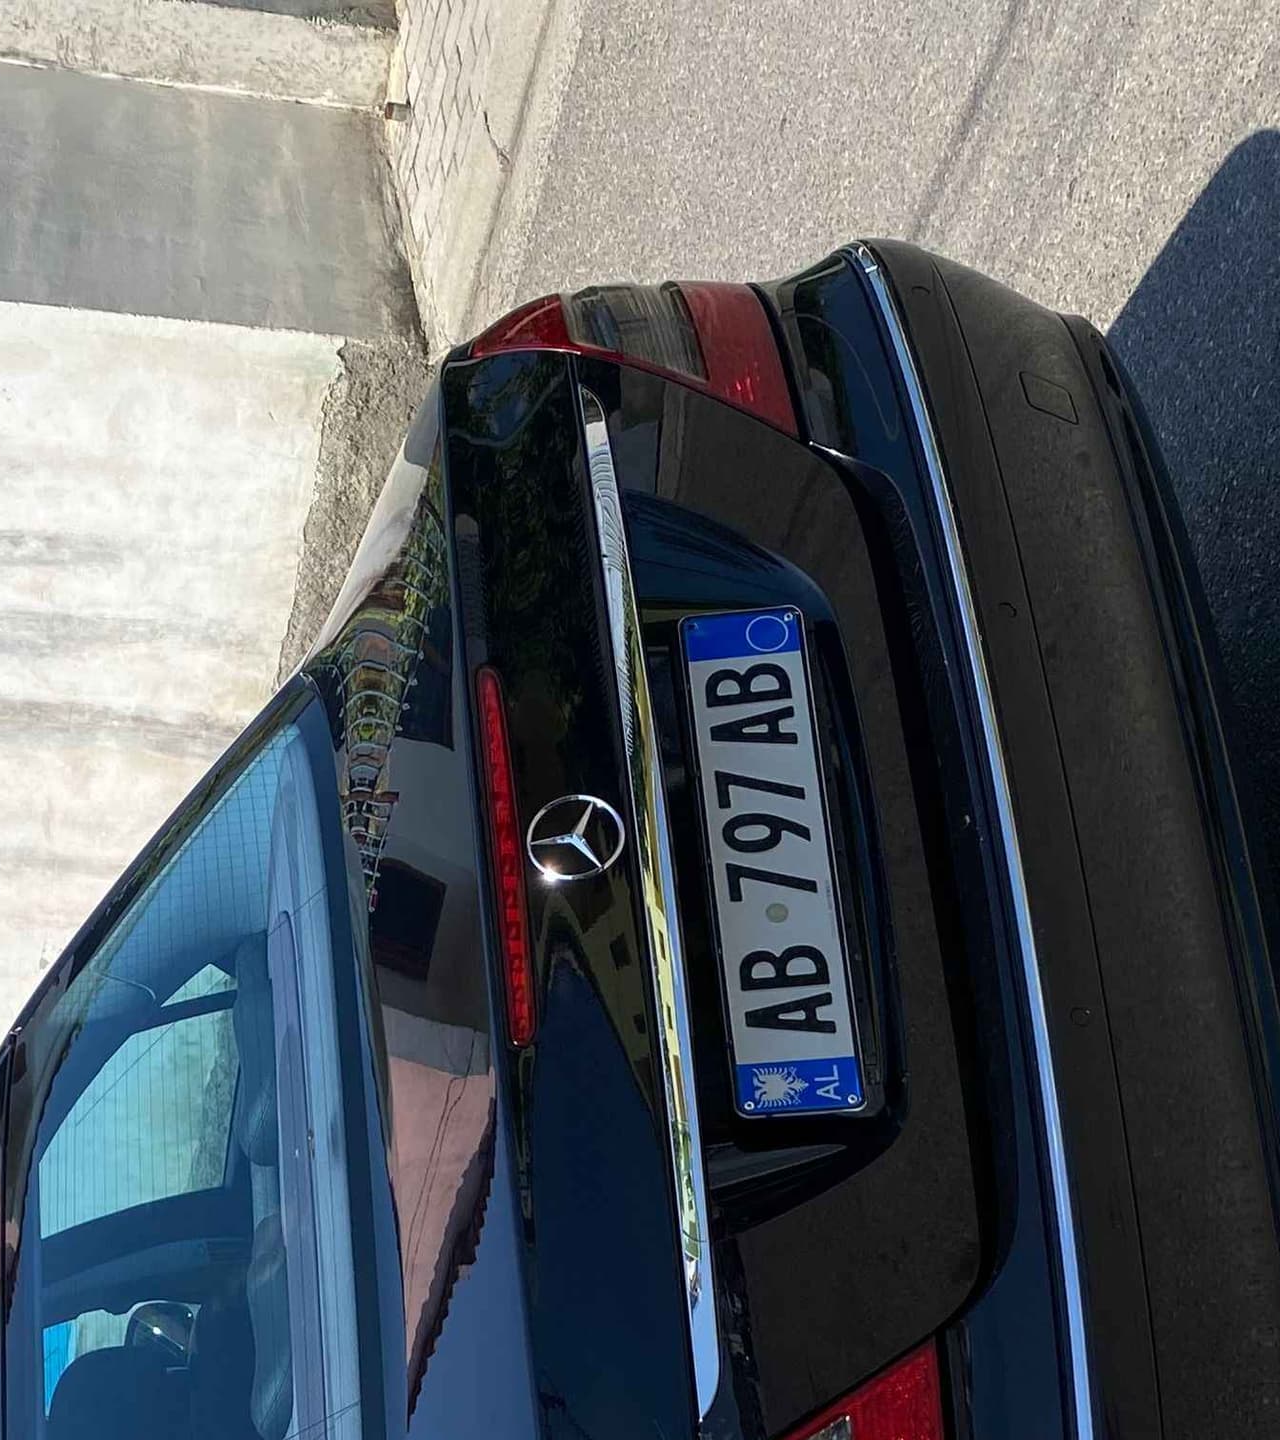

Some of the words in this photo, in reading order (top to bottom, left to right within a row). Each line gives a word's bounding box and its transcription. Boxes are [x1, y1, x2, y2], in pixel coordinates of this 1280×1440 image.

[705, 663, 799, 745] AB
[714, 770, 818, 902] 797
[739, 945, 837, 1034] AB
[815, 1064, 842, 1100] AL
